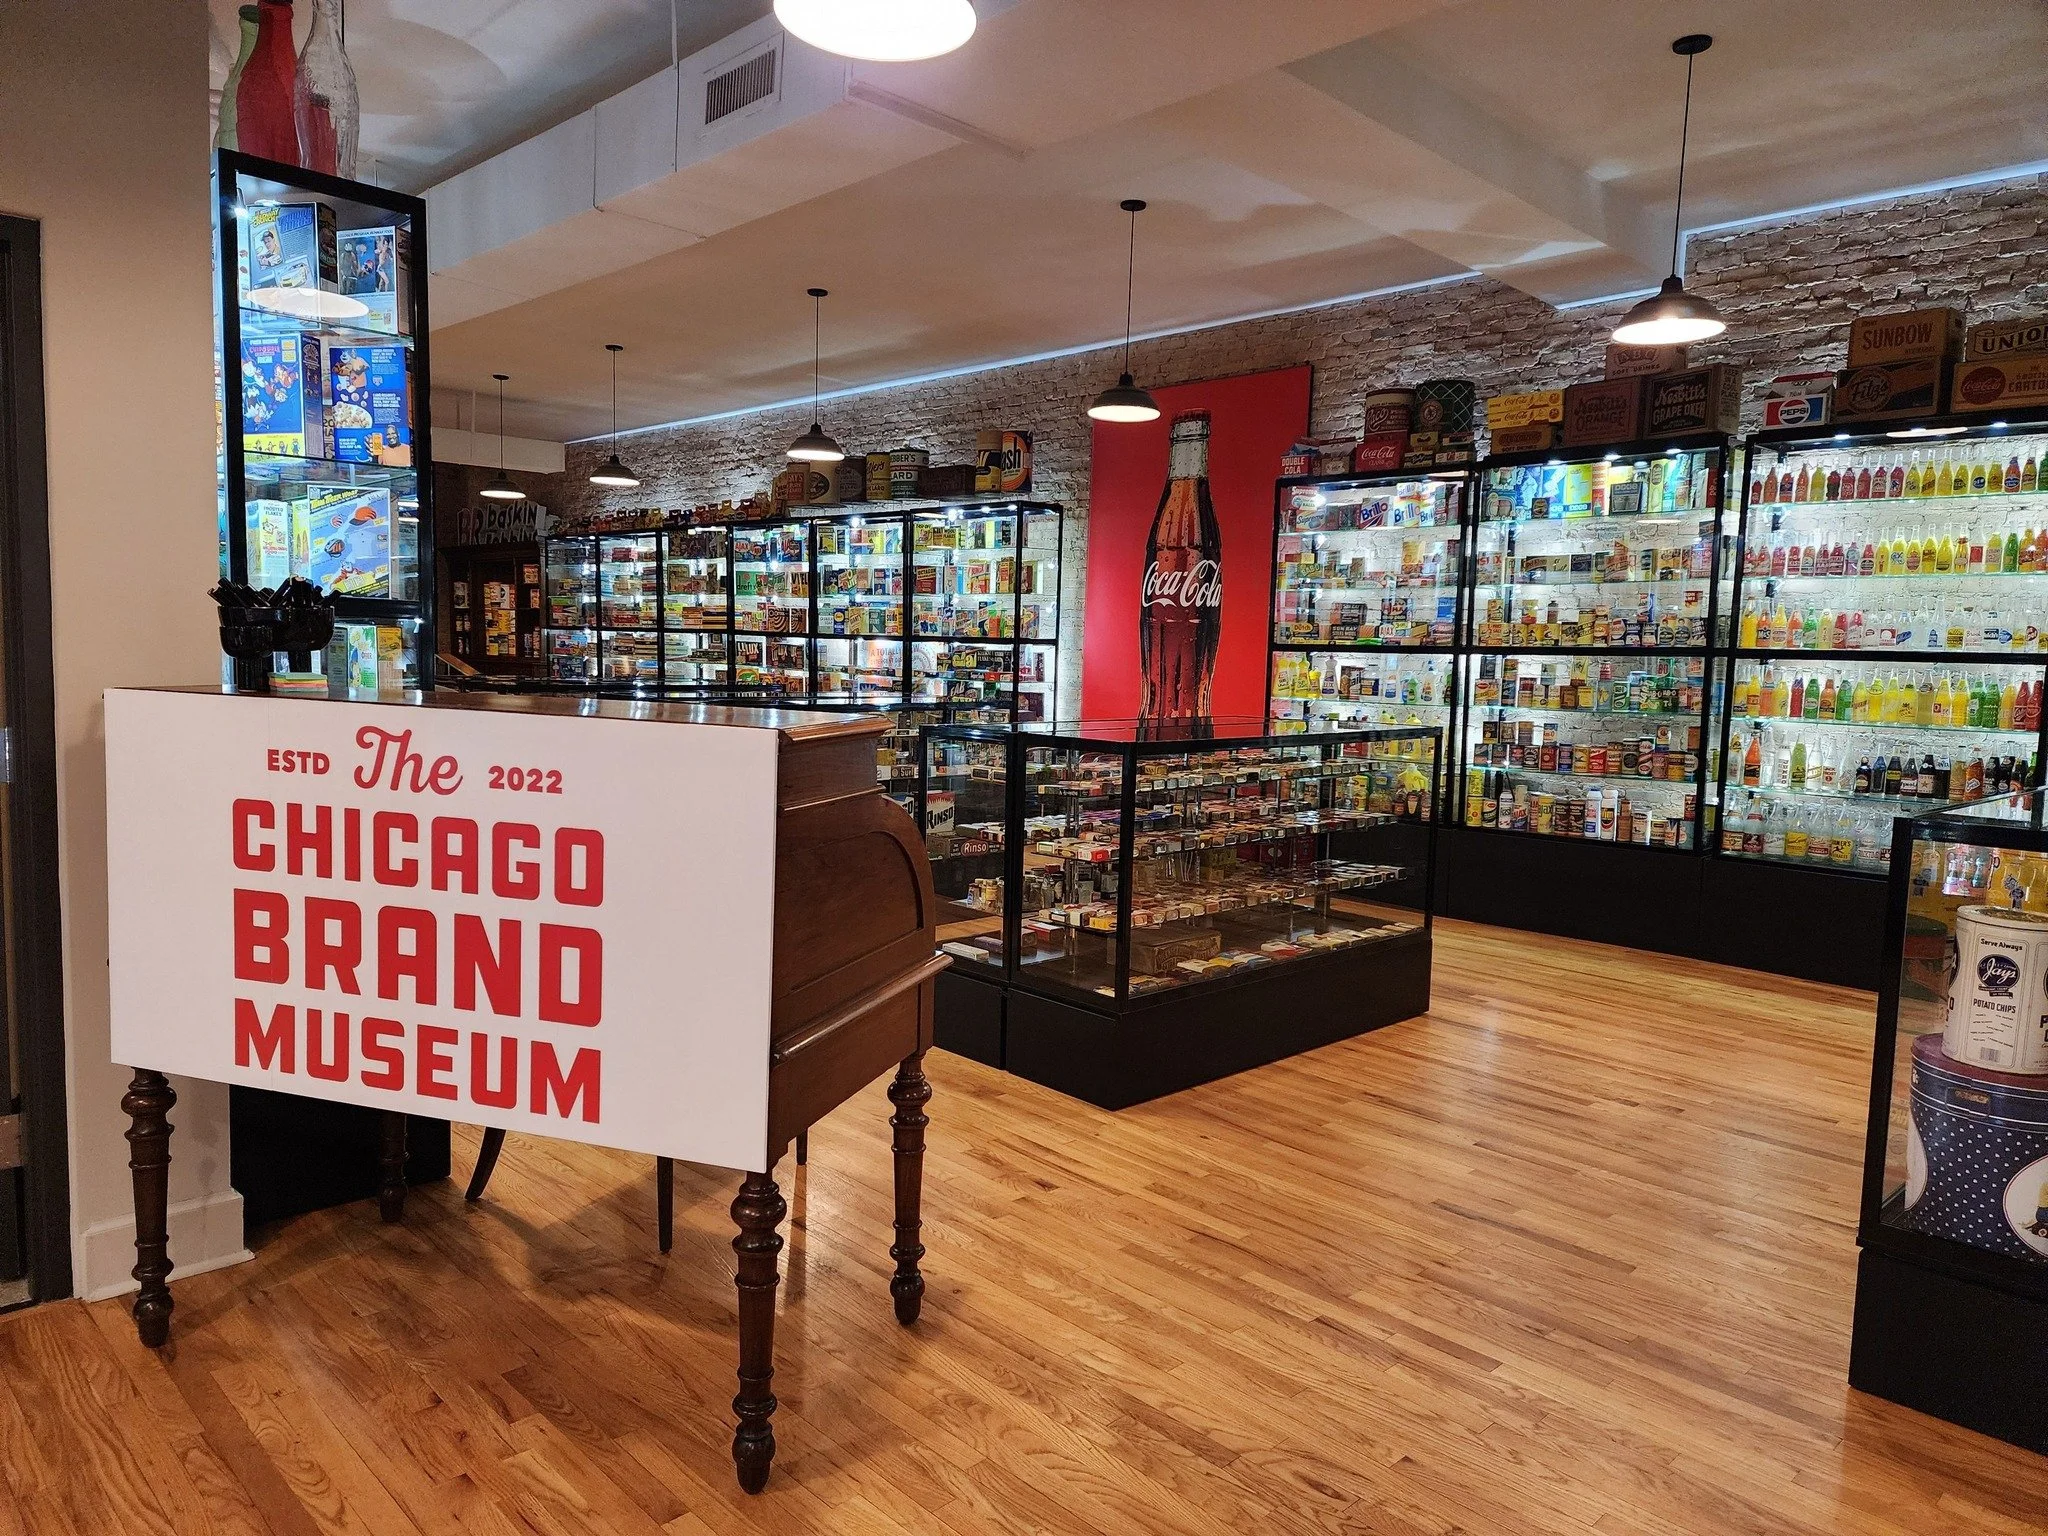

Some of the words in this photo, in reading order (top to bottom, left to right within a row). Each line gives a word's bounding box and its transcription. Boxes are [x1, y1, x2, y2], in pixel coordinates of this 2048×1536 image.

[1862, 322, 1933, 349] SUNBOW
[1983, 326, 2048, 352] UNIO
[1612, 368, 1629, 376] SOFT
[2008, 380, 2048, 393] CARTO
[1652, 406, 1683, 425] GRAPE
[1780, 407, 1809, 417] PEPSI
[1001, 437, 1021, 471] ash
[1281, 456, 1305, 467] DOUBLE
[891, 471, 913, 480] ARD
[1284, 466, 1302, 475] COLA
[1296, 513, 1325, 524] Supreme
[1361, 502, 1388, 521] Brillo
[1394, 503, 1420, 523] Brillo
[1142, 558, 1221, 609] Coca-Cola
[267, 748, 330, 775] ESTD
[354, 725, 463, 796] The
[489, 765, 562, 794] 2022
[927, 806, 955, 830] RINSO
[232, 798, 605, 907] CHICAGO
[963, 841, 988, 854] Rinso
[1980, 938, 1998, 948] Serve
[1998, 941, 2023, 952] Always
[233, 888, 604, 1027] BRAND
[1983, 957, 2017, 984] Jays
[1973, 998, 1995, 1011] POTATO
[1996, 1003, 2017, 1014] CHIPS
[234, 998, 602, 1123] MUSEUM
